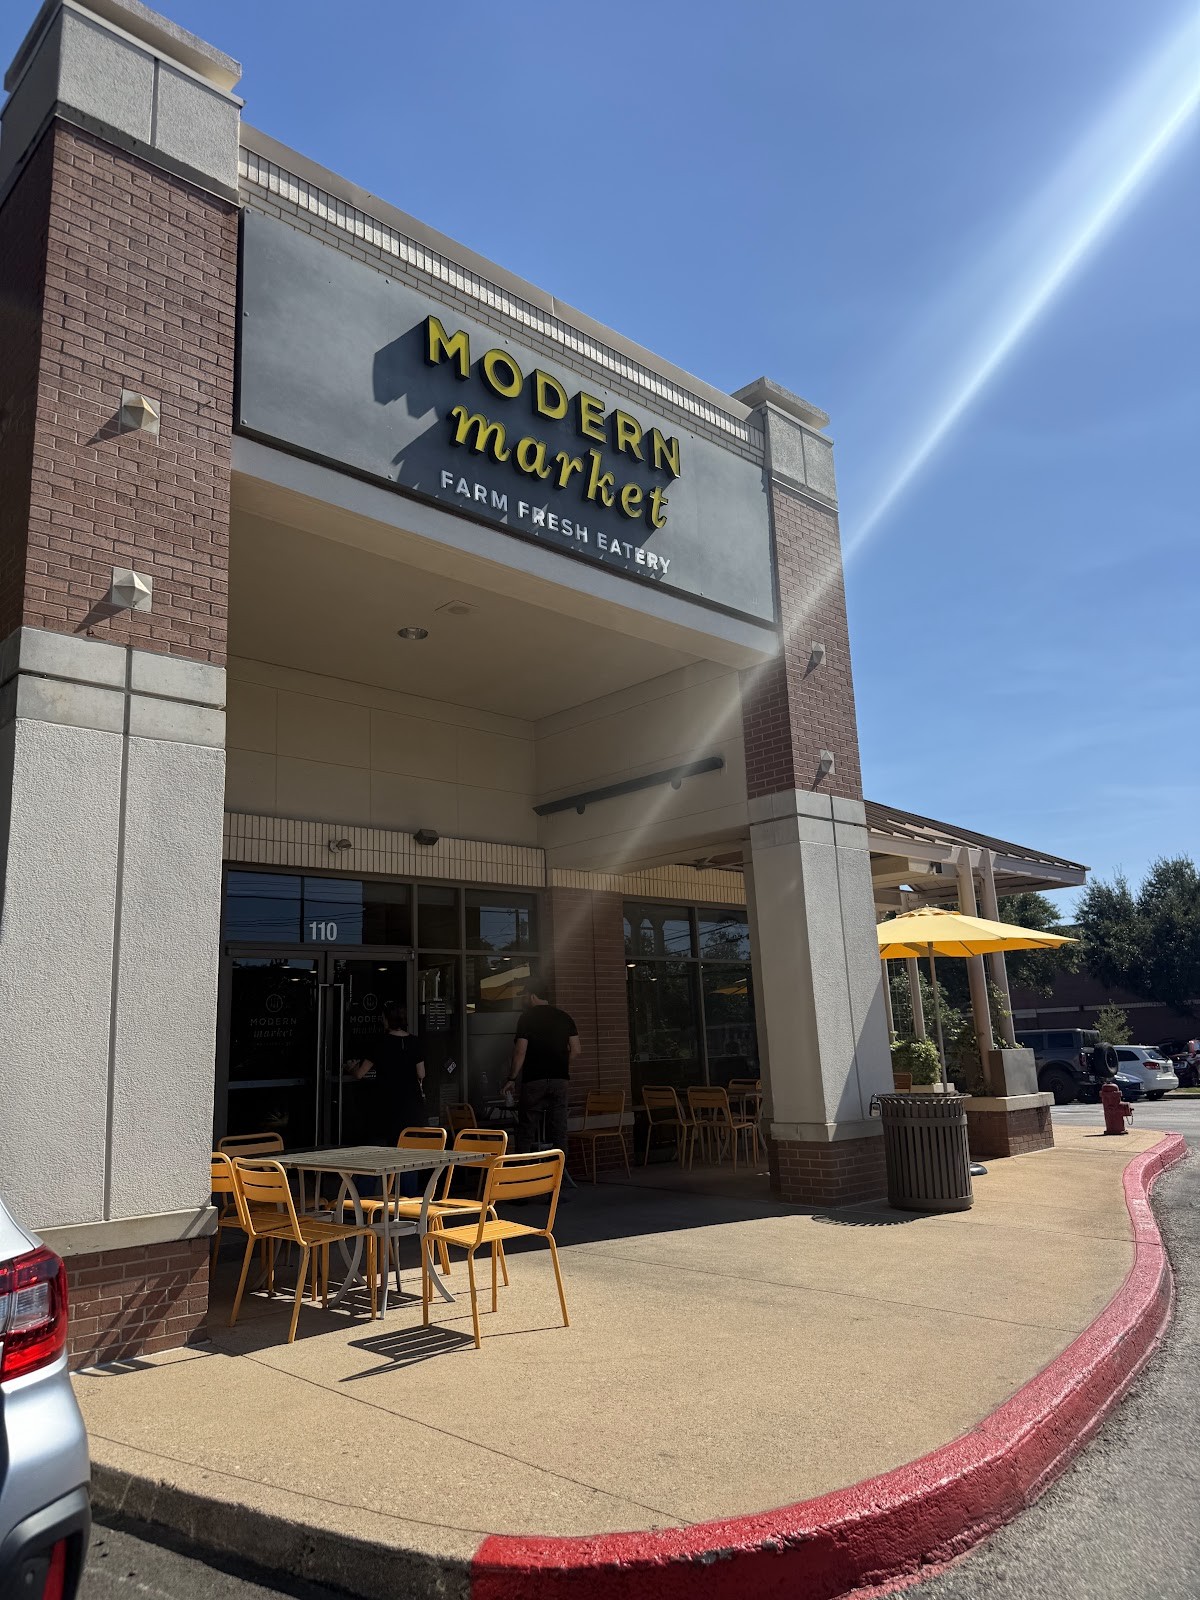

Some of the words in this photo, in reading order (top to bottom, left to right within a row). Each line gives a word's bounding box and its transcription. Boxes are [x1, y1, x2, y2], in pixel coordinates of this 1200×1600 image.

[424, 315, 681, 478] MODERN
[447, 404, 669, 529] market
[440, 469, 508, 512] FARM
[517, 500, 589, 543] FRESH
[597, 532, 671, 574] EATERY
[309, 921, 338, 941] 110
[250, 1017, 297, 1026] MODERN
[349, 1015, 384, 1024] MODER
[253, 1027, 293, 1038] market
